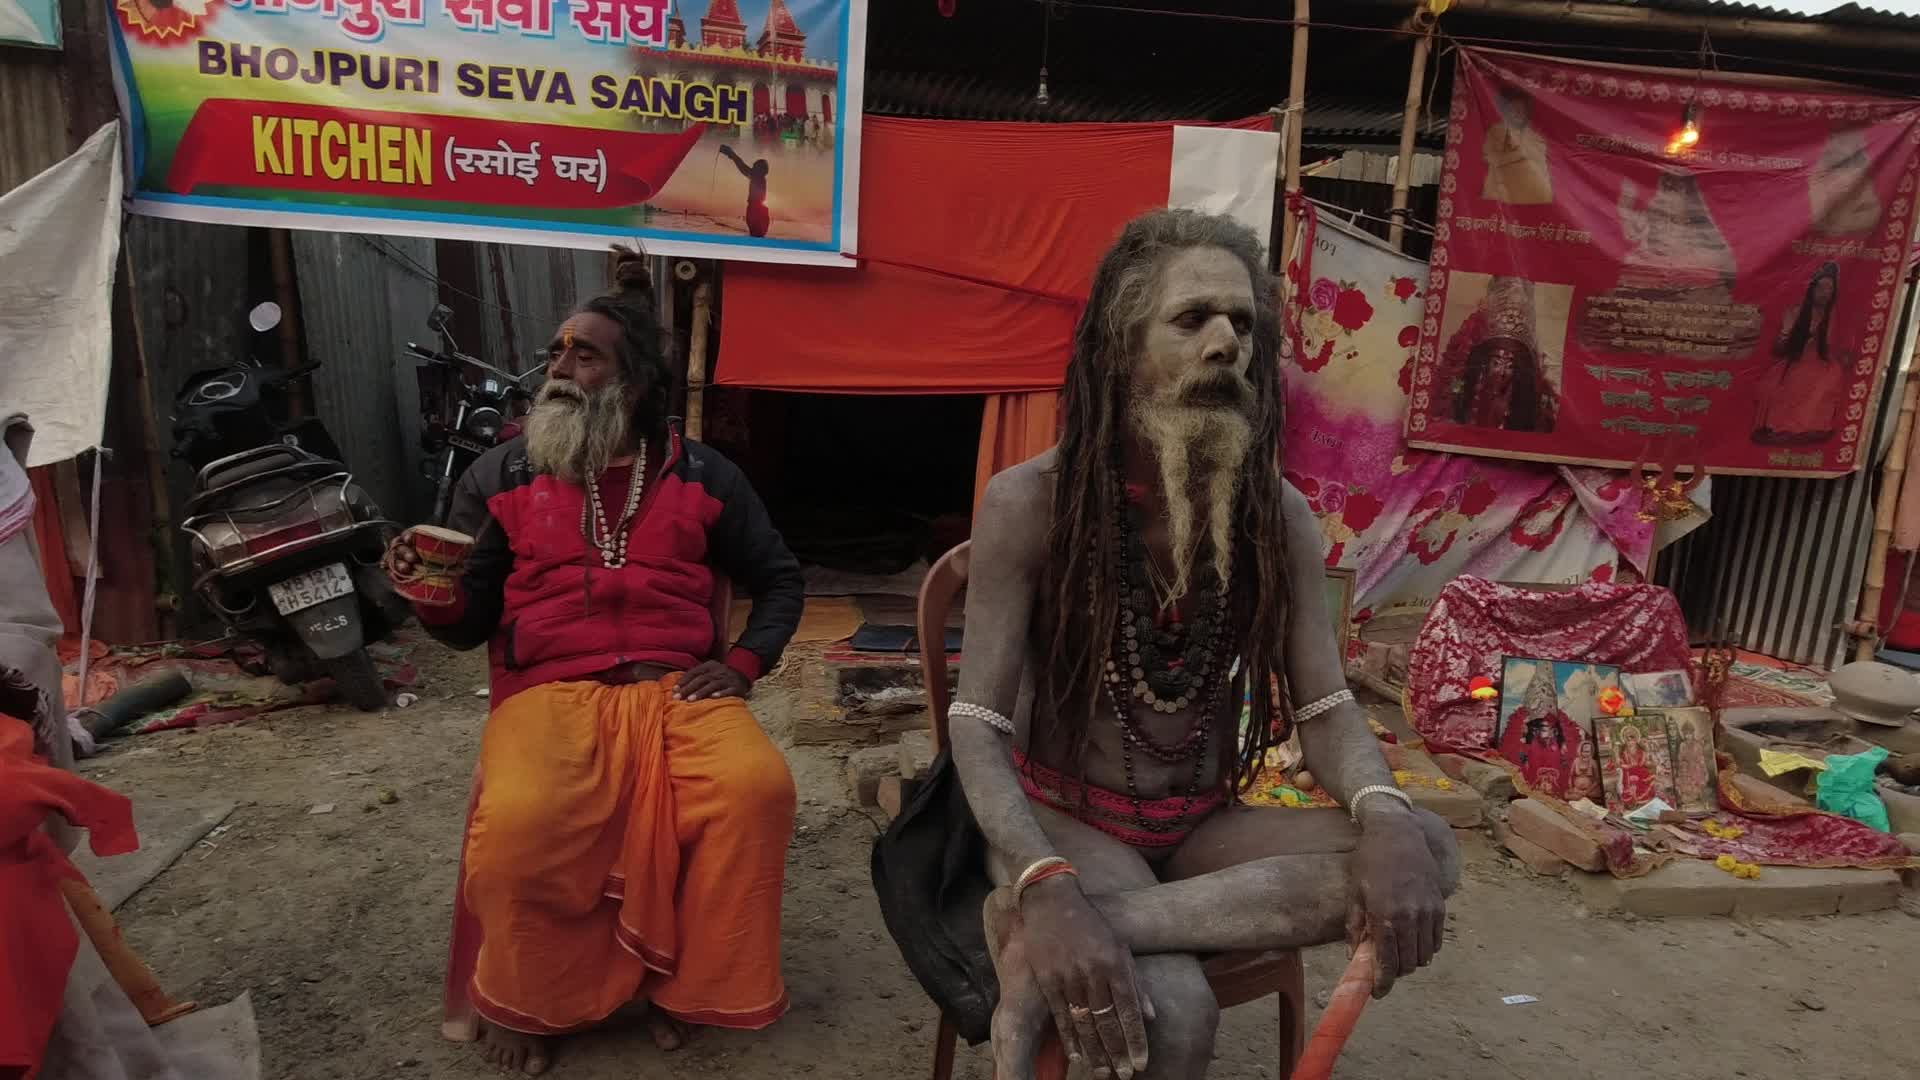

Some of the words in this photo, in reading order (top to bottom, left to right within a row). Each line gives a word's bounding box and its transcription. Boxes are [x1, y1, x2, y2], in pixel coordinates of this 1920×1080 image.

[197, 40, 441, 94] BHOJPURI
[456, 62, 577, 107] SEVA
[590, 75, 749, 124] SANGH
[252, 115, 432, 186] KITCHEN
[444, 136, 542, 185] (रसोई
[551, 148, 608, 193] घर)
